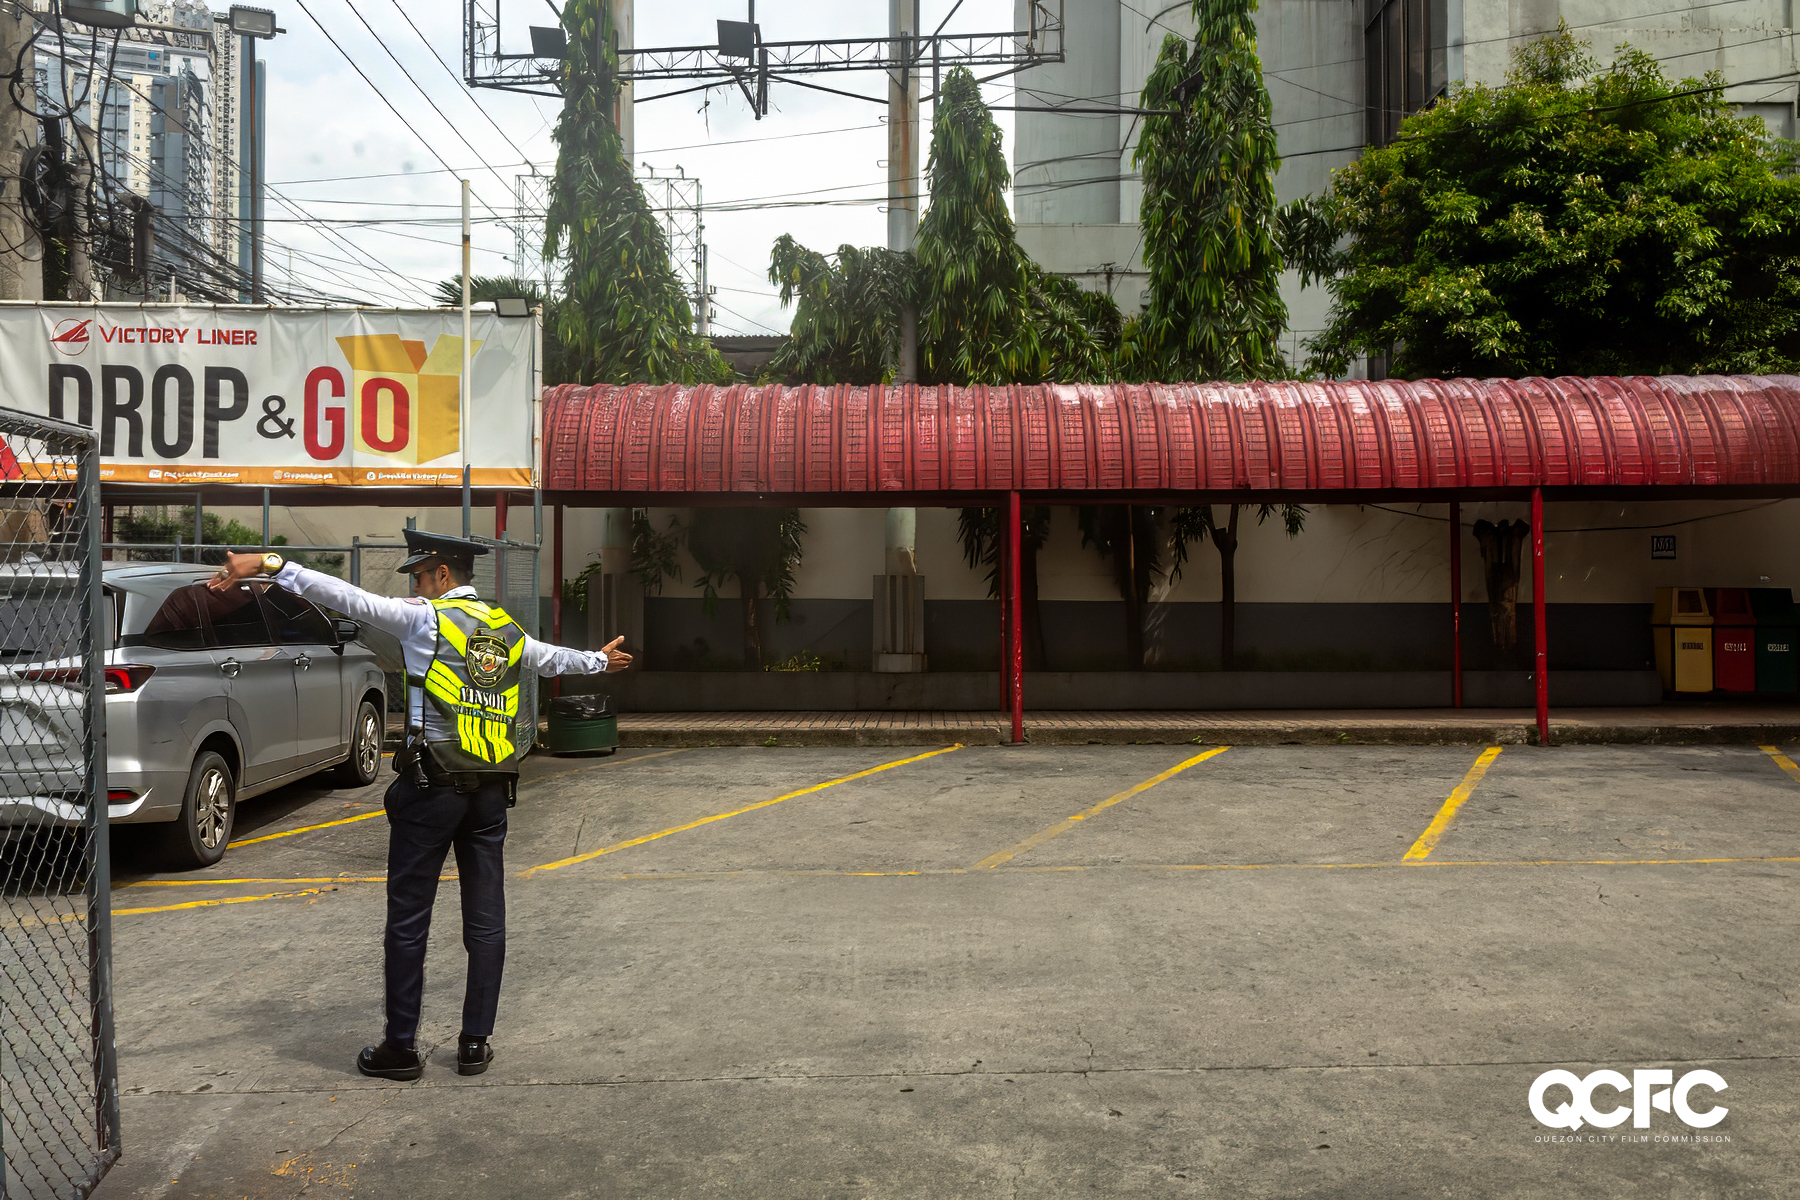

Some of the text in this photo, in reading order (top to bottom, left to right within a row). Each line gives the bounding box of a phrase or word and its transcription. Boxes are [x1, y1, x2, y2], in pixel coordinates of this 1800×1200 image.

[98, 325, 258, 346] VICTORY LINER
[46, 363, 410, 461] DROP & GO
